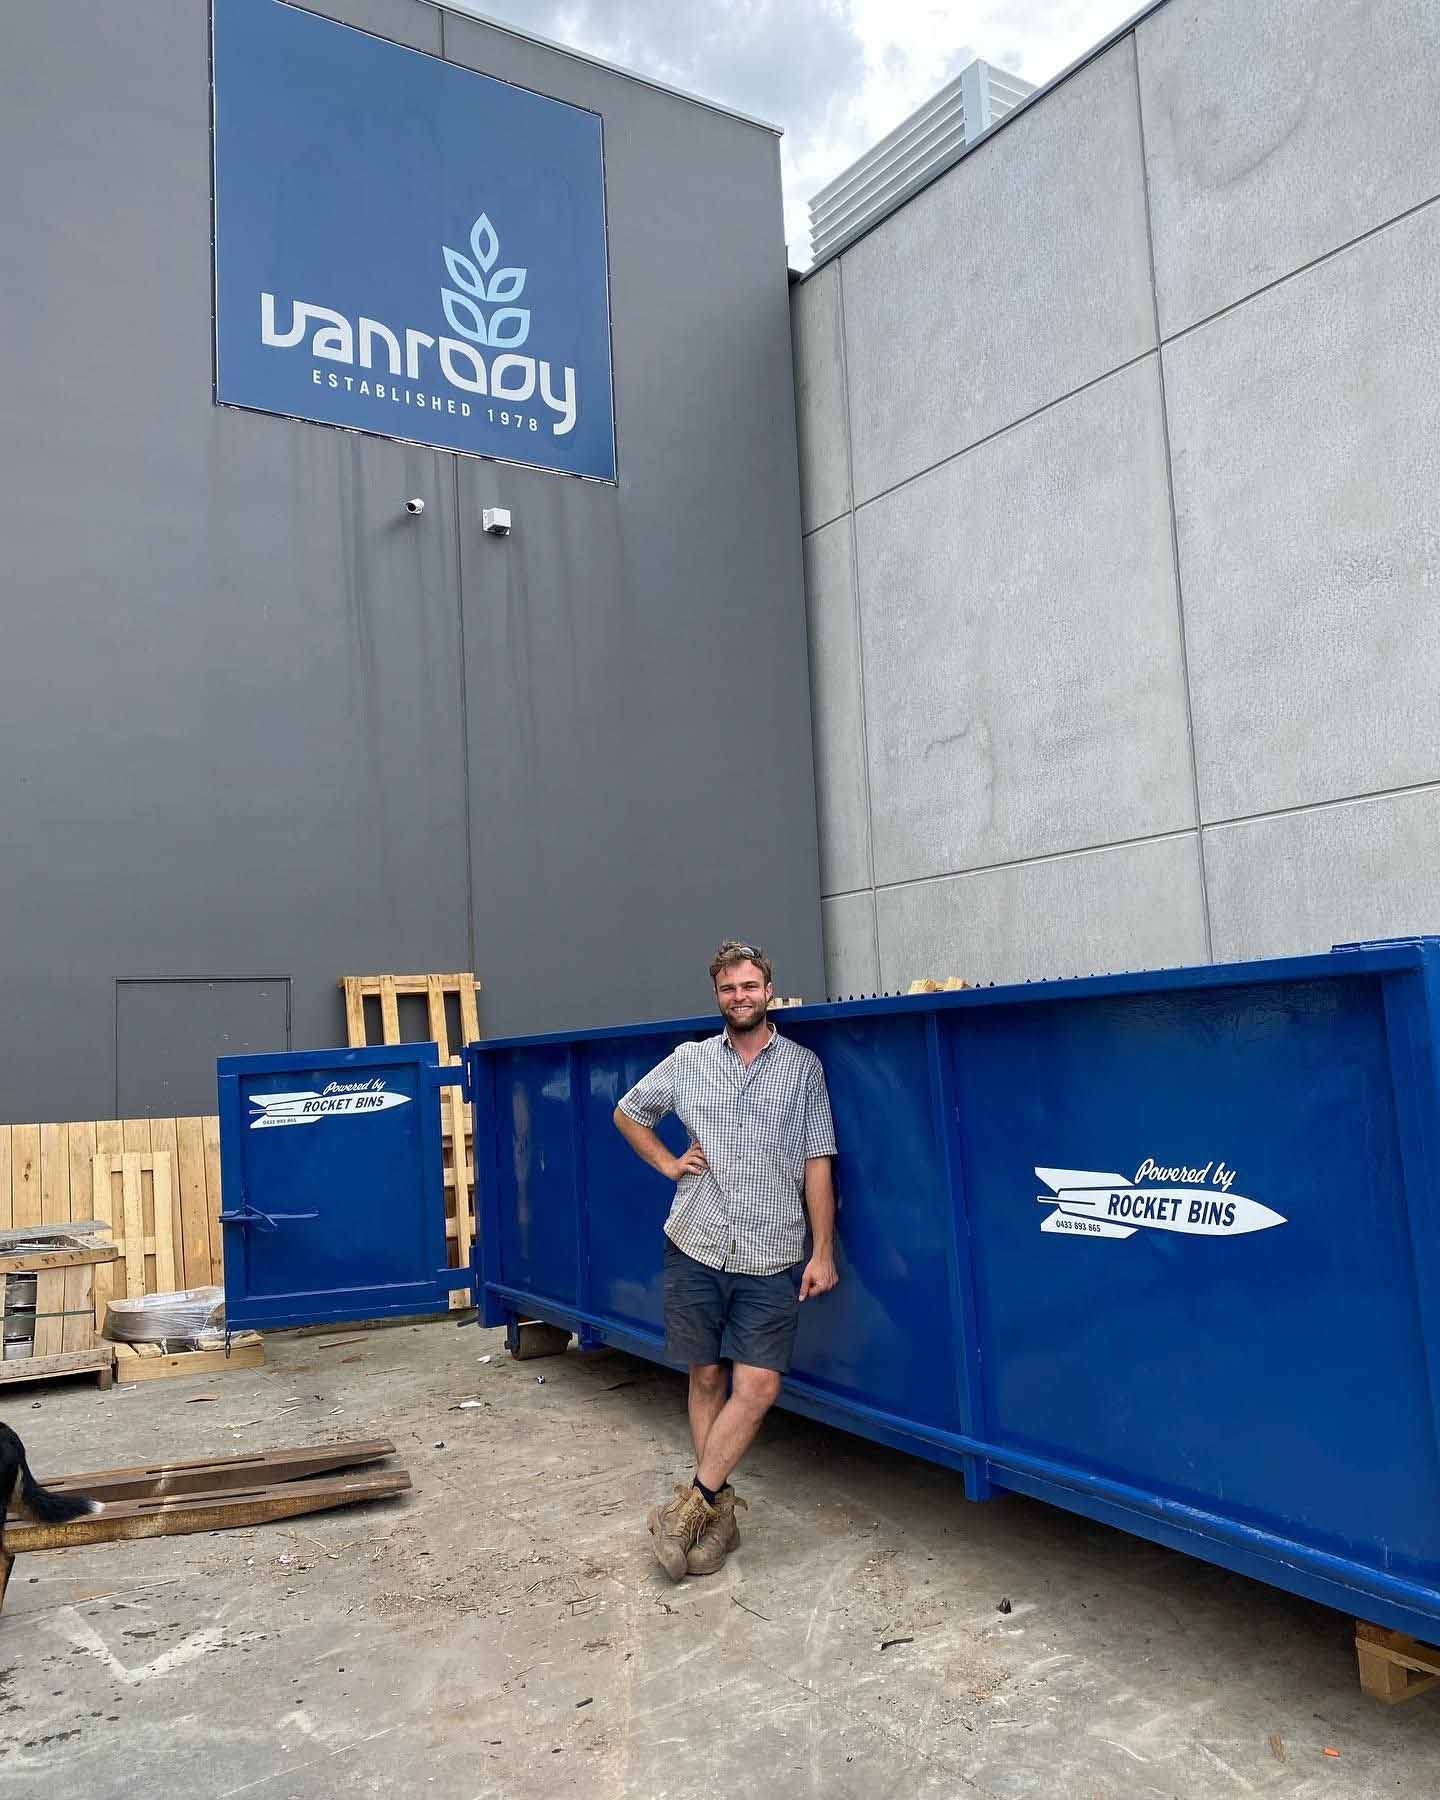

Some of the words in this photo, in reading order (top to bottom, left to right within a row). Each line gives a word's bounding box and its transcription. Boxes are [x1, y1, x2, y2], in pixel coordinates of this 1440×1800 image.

[261, 292, 577, 435] vanrooy
[312, 369, 472, 417] ESTABLISHED
[487, 408, 538, 431] 1978
[322, 1079, 373, 1096] Powered
[370, 1078, 386, 1092] by
[302, 1098, 352, 1113] ROCKET
[355, 1095, 385, 1109] BINS
[1134, 1158, 1213, 1184] Powered
[1212, 1161, 1237, 1192] by
[1056, 1219, 1072, 1229] 0433
[1108, 1193, 1183, 1222] ROCKET
[1187, 1201, 1237, 1226] BINS
